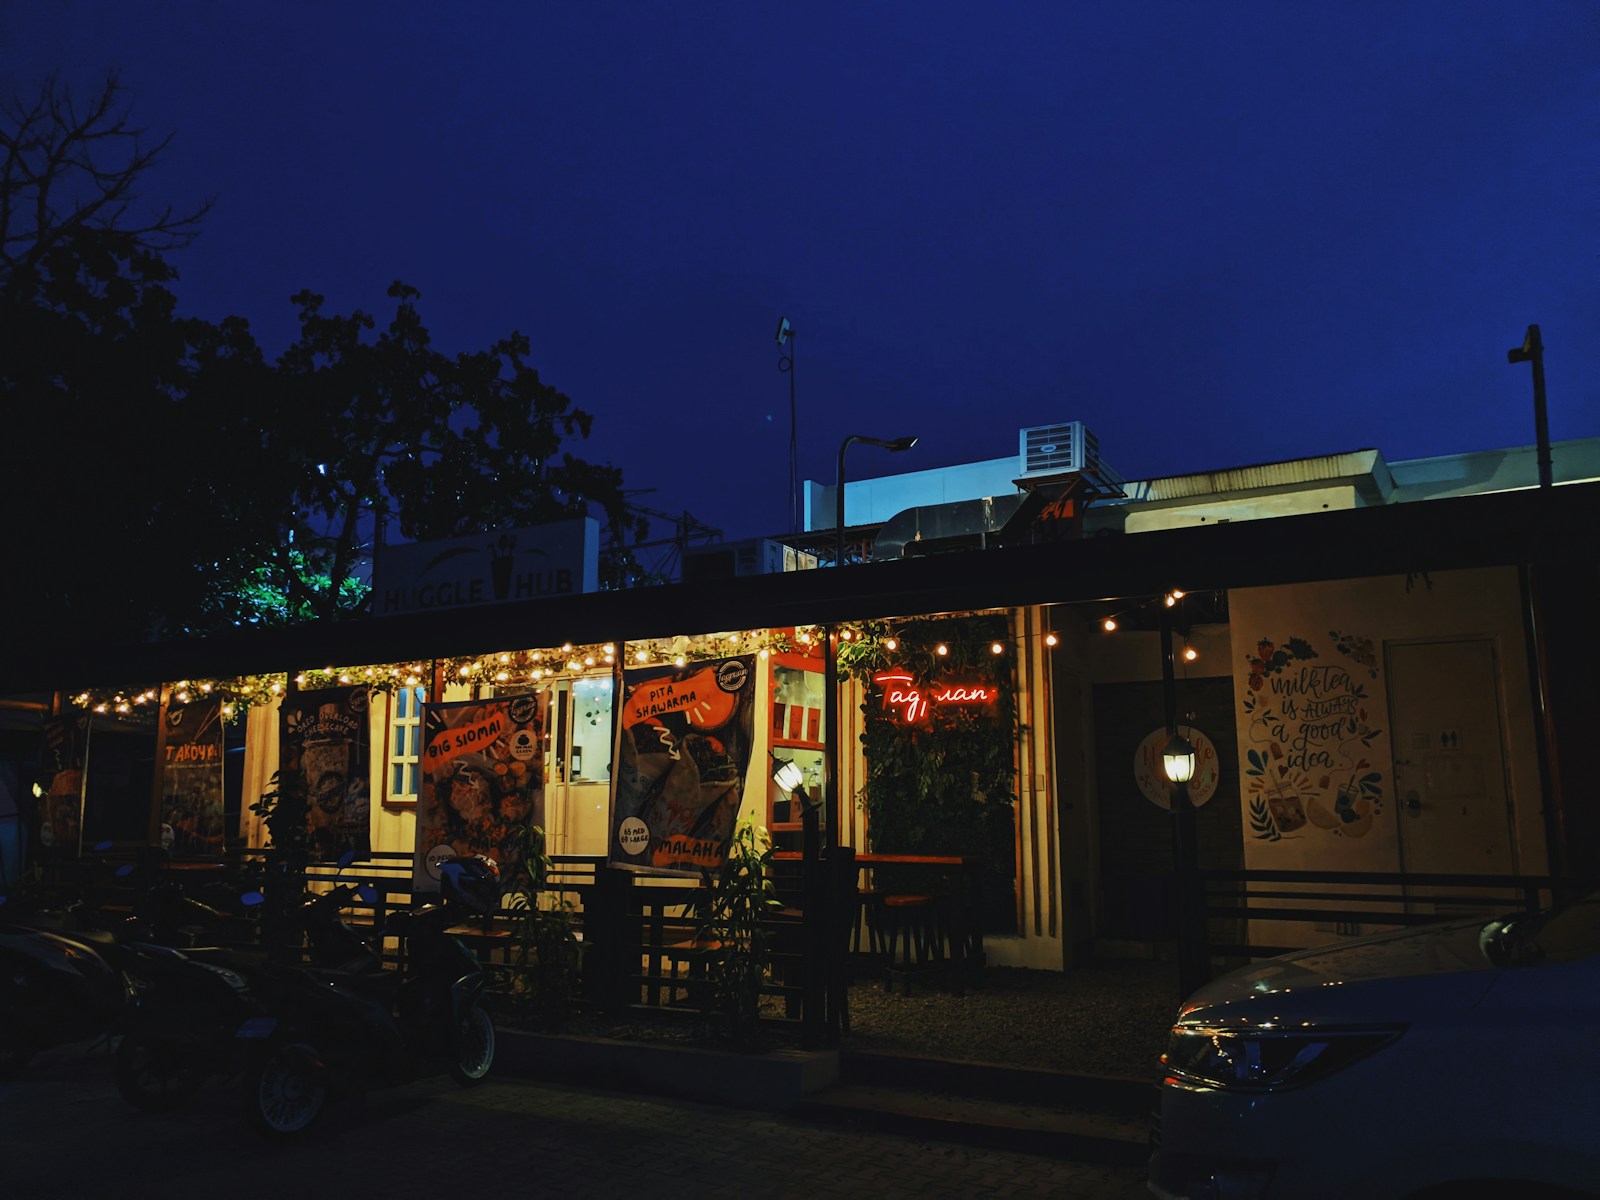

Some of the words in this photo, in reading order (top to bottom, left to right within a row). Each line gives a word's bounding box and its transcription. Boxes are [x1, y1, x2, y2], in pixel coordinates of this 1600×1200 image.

[383, 578, 485, 612] HUGGLE
[515, 568, 573, 599] HUB
[636, 691, 697, 719] SHAWARMA
[650, 684, 674, 702] PITA
[1281, 695, 1298, 720] is
[1301, 697, 1358, 719] ALWAYS
[297, 715, 315, 734] OREO
[319, 711, 359, 730] OVERLOAD
[304, 722, 349, 738] CHEESECAKE
[1271, 723, 1290, 743] a
[1293, 717, 1346, 751] good
[429, 739, 451, 759] BIG
[455, 719, 501, 749] SIOMAI
[629, 835, 648, 843] LARGE
[632, 827, 646, 836] MED
